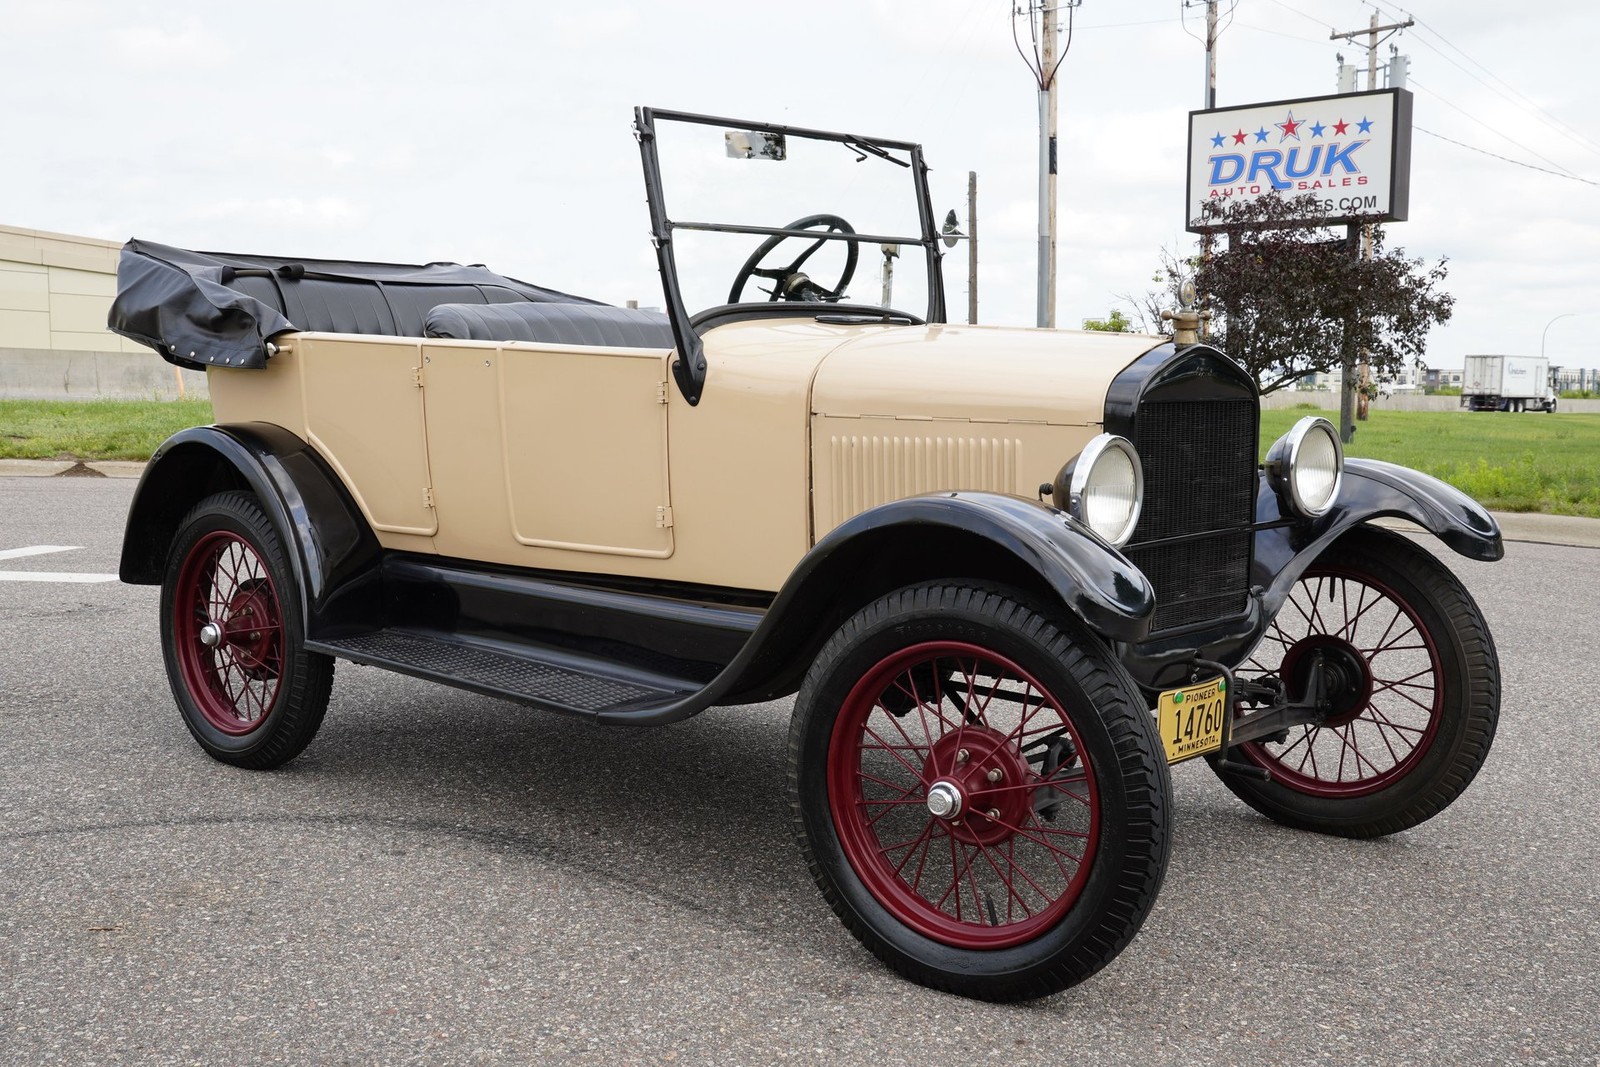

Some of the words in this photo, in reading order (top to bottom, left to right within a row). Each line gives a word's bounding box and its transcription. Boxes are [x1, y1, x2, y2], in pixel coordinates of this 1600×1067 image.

[1208, 139, 1371, 190] DRUK
[1209, 185, 1261, 198] AUTO
[1298, 176, 1368, 190] SALES
[1186, 688, 1216, 704] PIONEER
[1173, 699, 1222, 745] 14760
[1178, 736, 1216, 754] MINNESOTA
